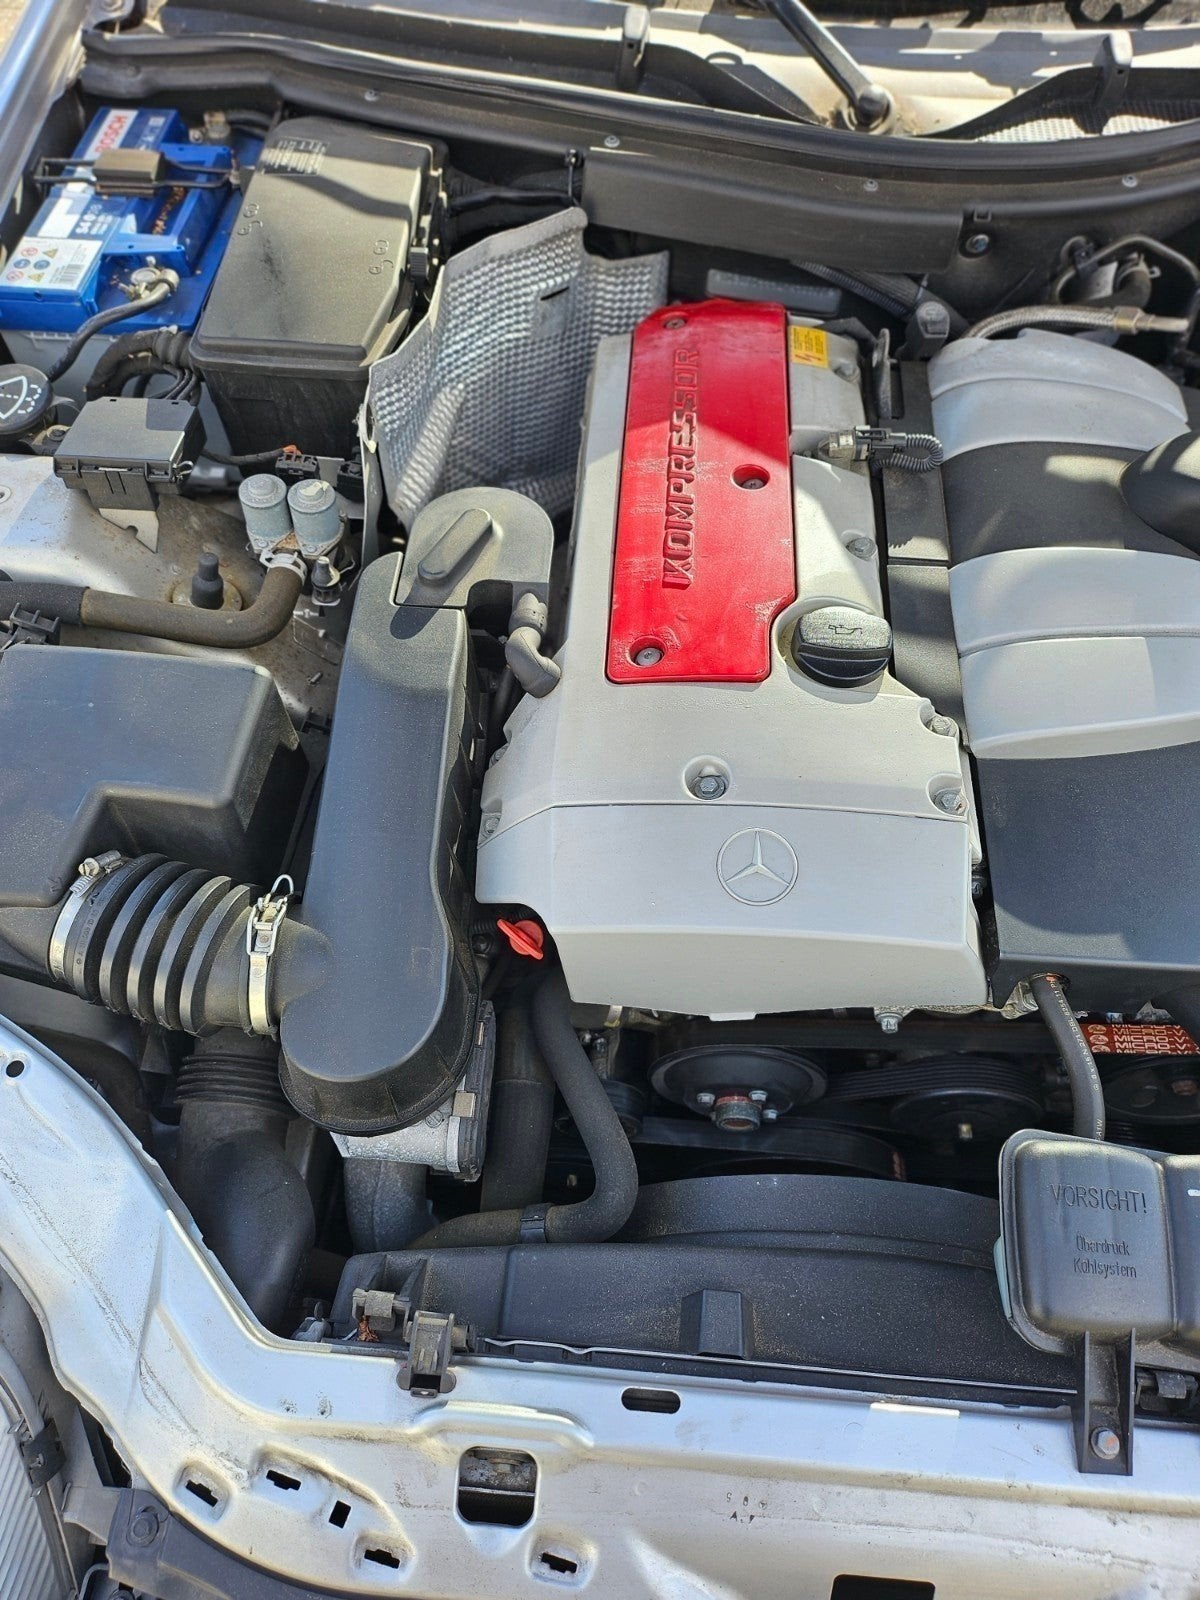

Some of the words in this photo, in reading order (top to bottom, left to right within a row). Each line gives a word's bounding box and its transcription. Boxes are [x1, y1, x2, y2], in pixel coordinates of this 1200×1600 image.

[661, 349, 700, 590] KOMPRESSOR
[1113, 1028, 1184, 1036] MICRO-V
[1114, 1035, 1186, 1043] MICRO-V
[1115, 1042, 1188, 1050] MICRO-V
[1050, 1183, 1148, 1214] VORSICHT!
